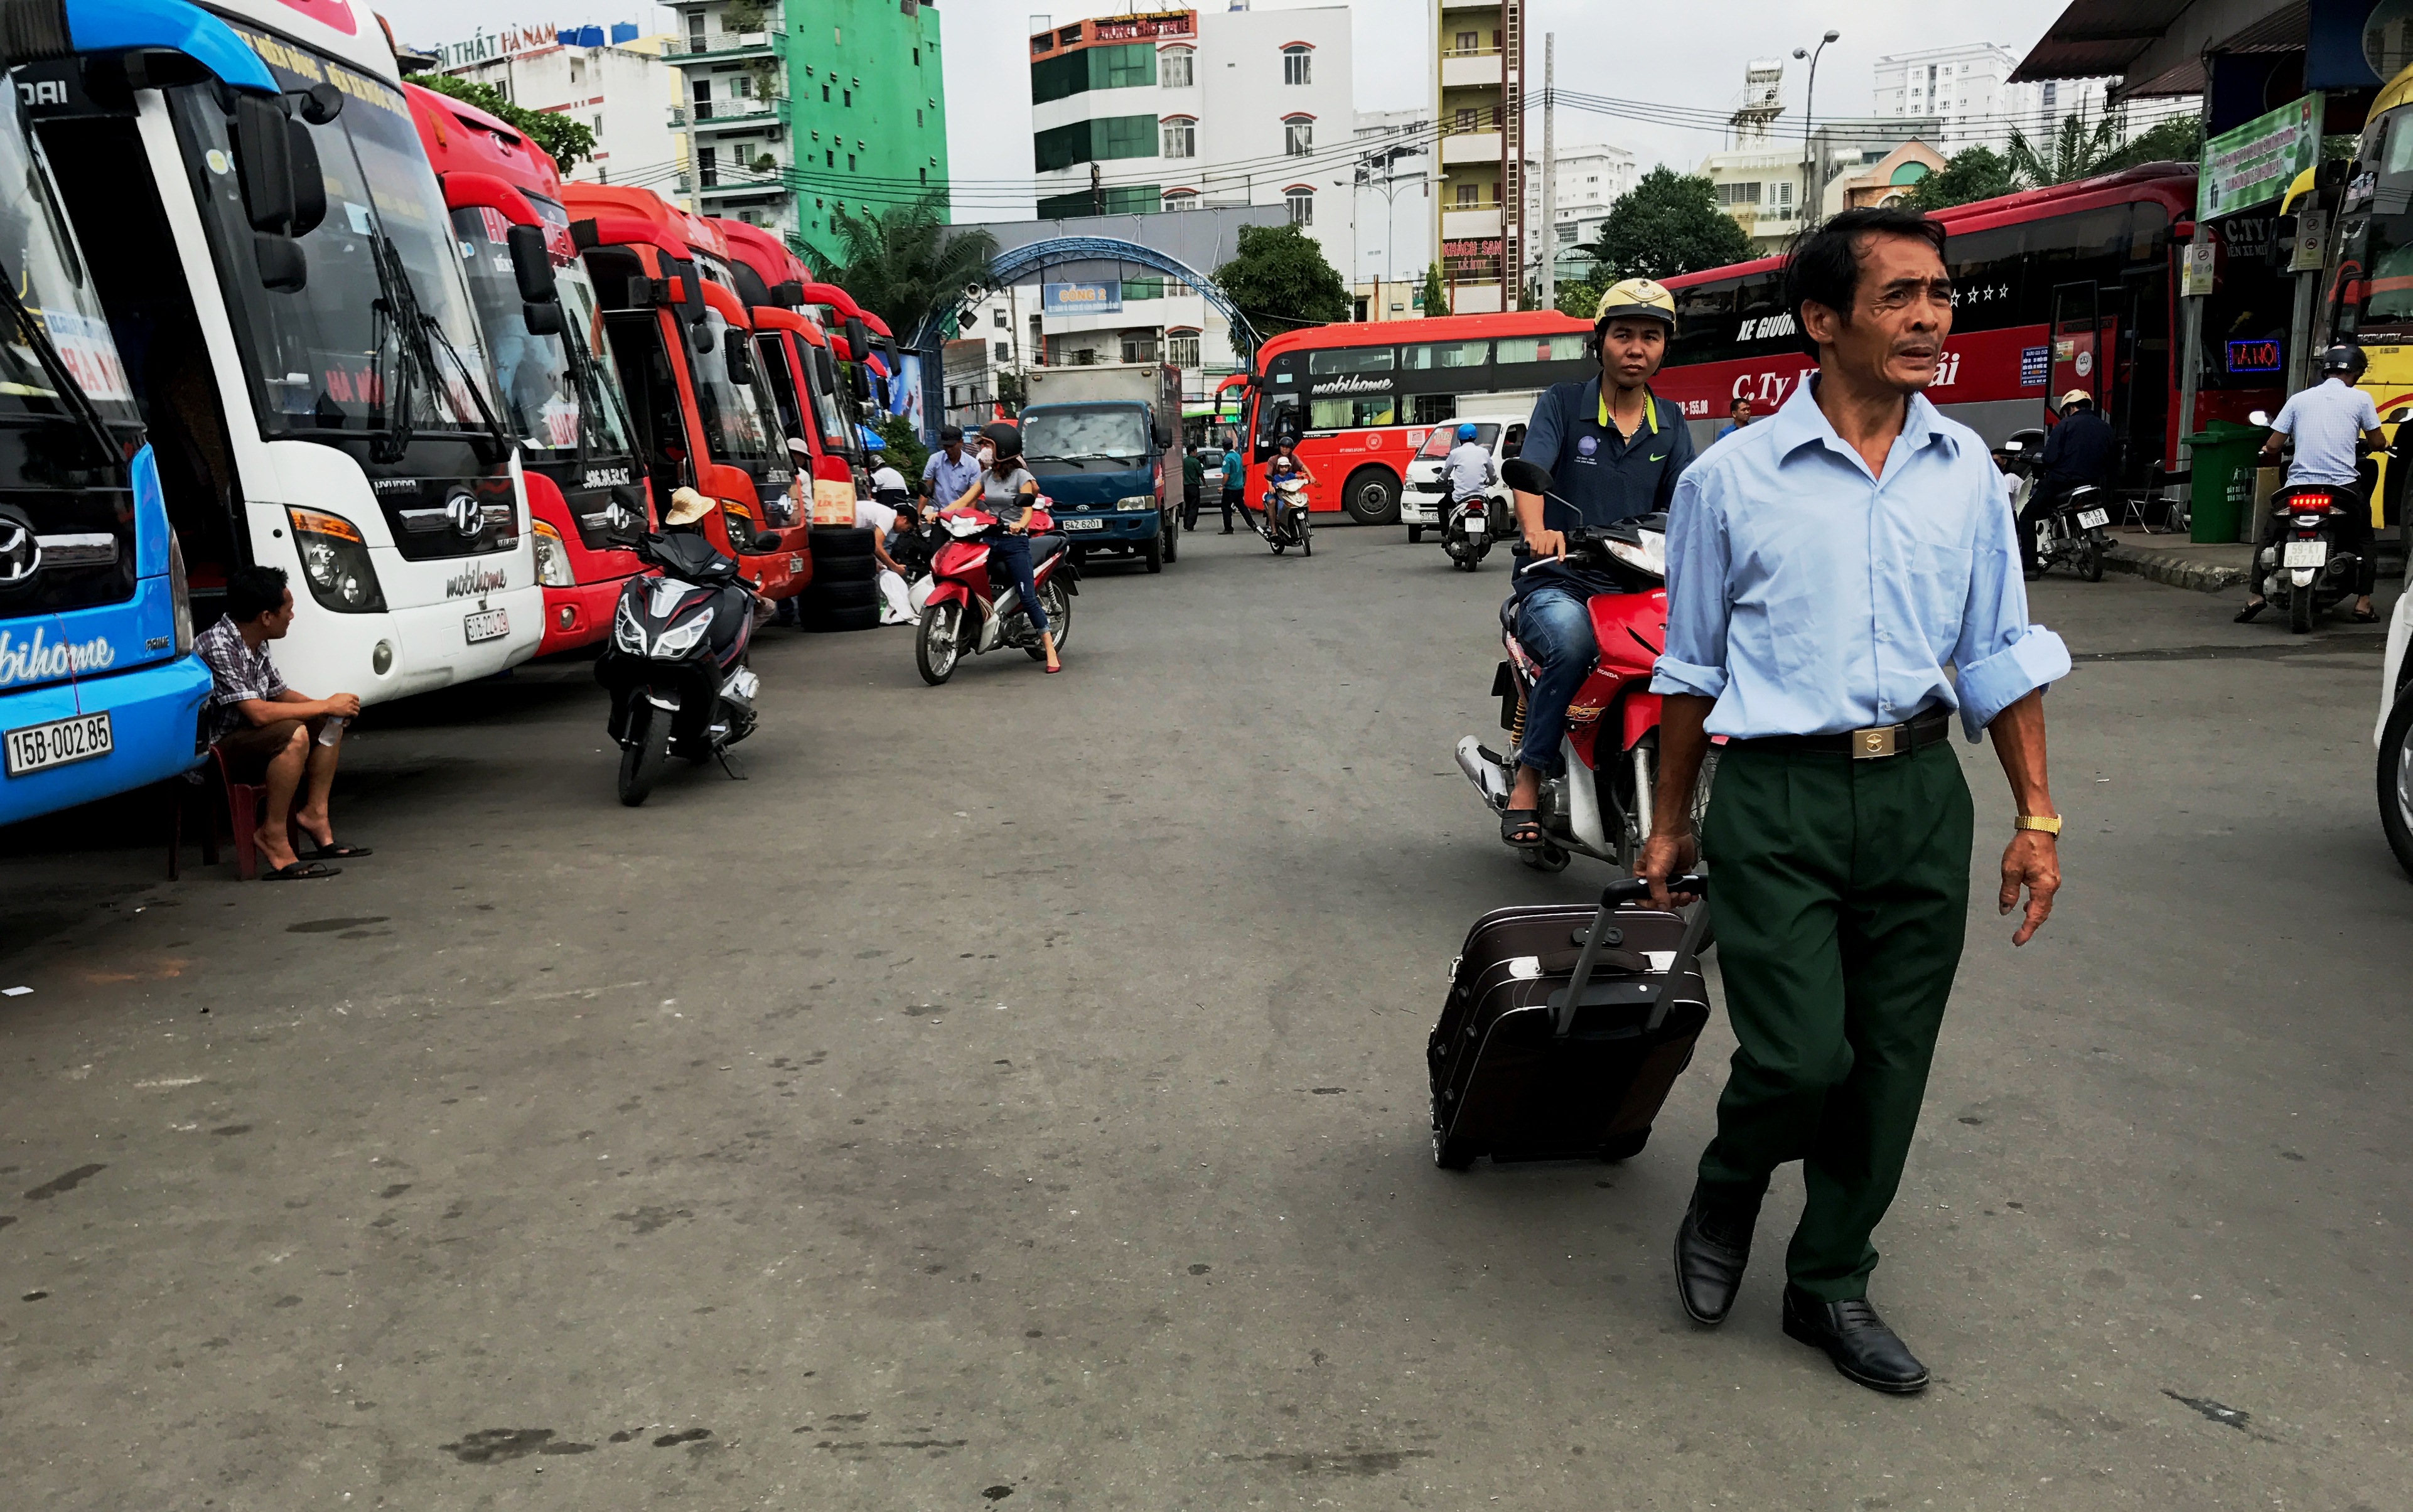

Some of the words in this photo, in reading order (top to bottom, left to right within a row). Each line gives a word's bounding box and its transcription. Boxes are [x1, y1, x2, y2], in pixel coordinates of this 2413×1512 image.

[453, 25, 497, 64] THẤT
[500, 22, 521, 53] HÀ
[522, 21, 559, 47] NAM
[2225, 219, 2265, 242] C.TY
[1443, 239, 1477, 257] KHÁCH
[1481, 240, 1502, 259] SẠN
[1059, 284, 1095, 303] CỔNG
[1098, 288, 1107, 300] 2
[1736, 319, 1757, 341] XE
[2231, 344, 2251, 365] HÀ
[2253, 343, 2276, 366] NỘI
[1311, 374, 1394, 395] mobihome
[447, 560, 507, 598] mobihome
[1597, 668, 1620, 680] HONDA
[13, 716, 108, 768] 15B-002.85
